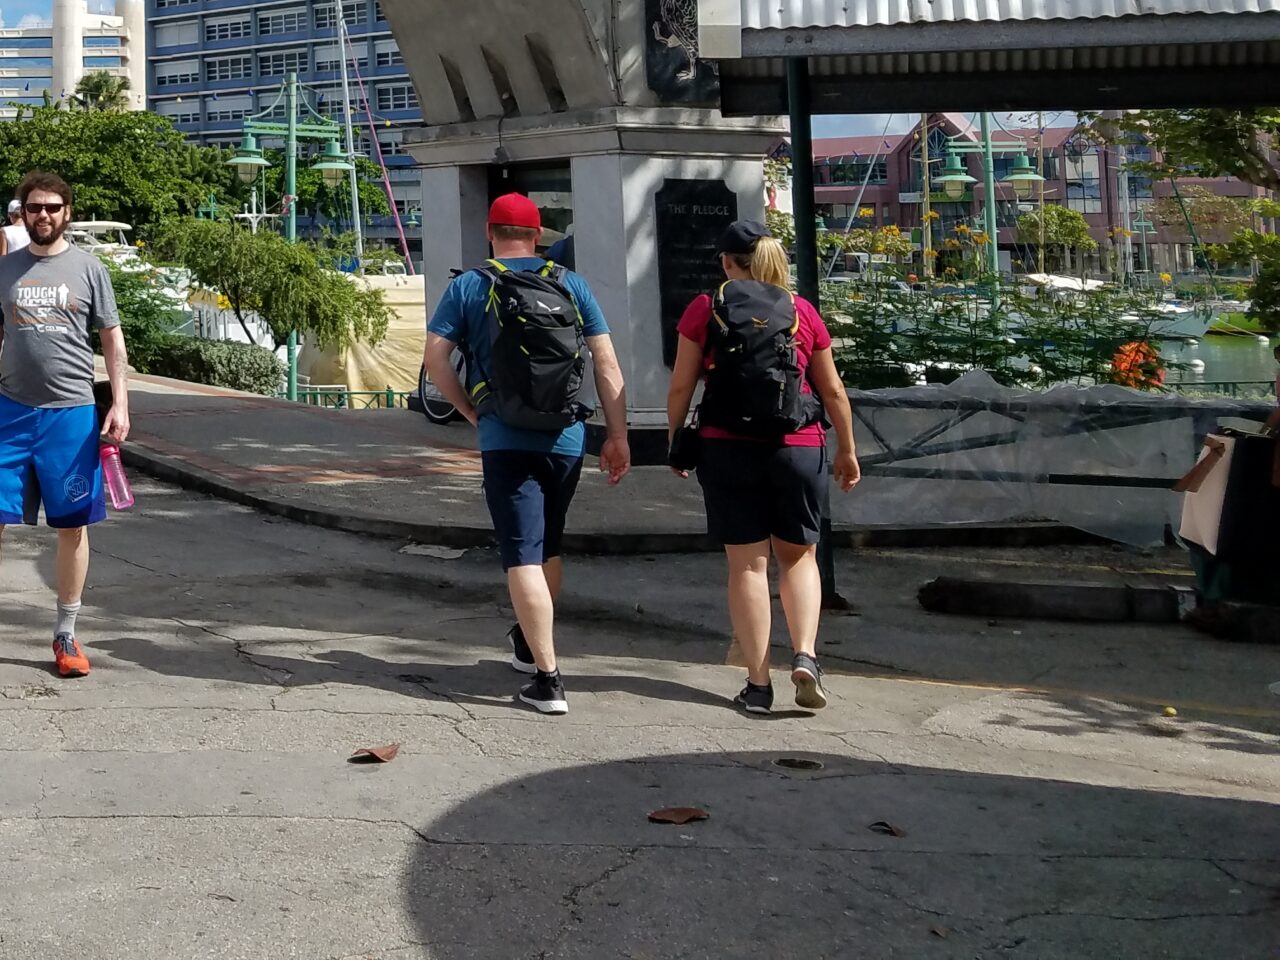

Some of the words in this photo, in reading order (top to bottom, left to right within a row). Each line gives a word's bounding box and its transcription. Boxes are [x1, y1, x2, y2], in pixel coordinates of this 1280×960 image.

[668, 203, 688, 215] THE
[692, 204, 730, 216] PLEDGE
[17, 286, 57, 299] TOUGH
